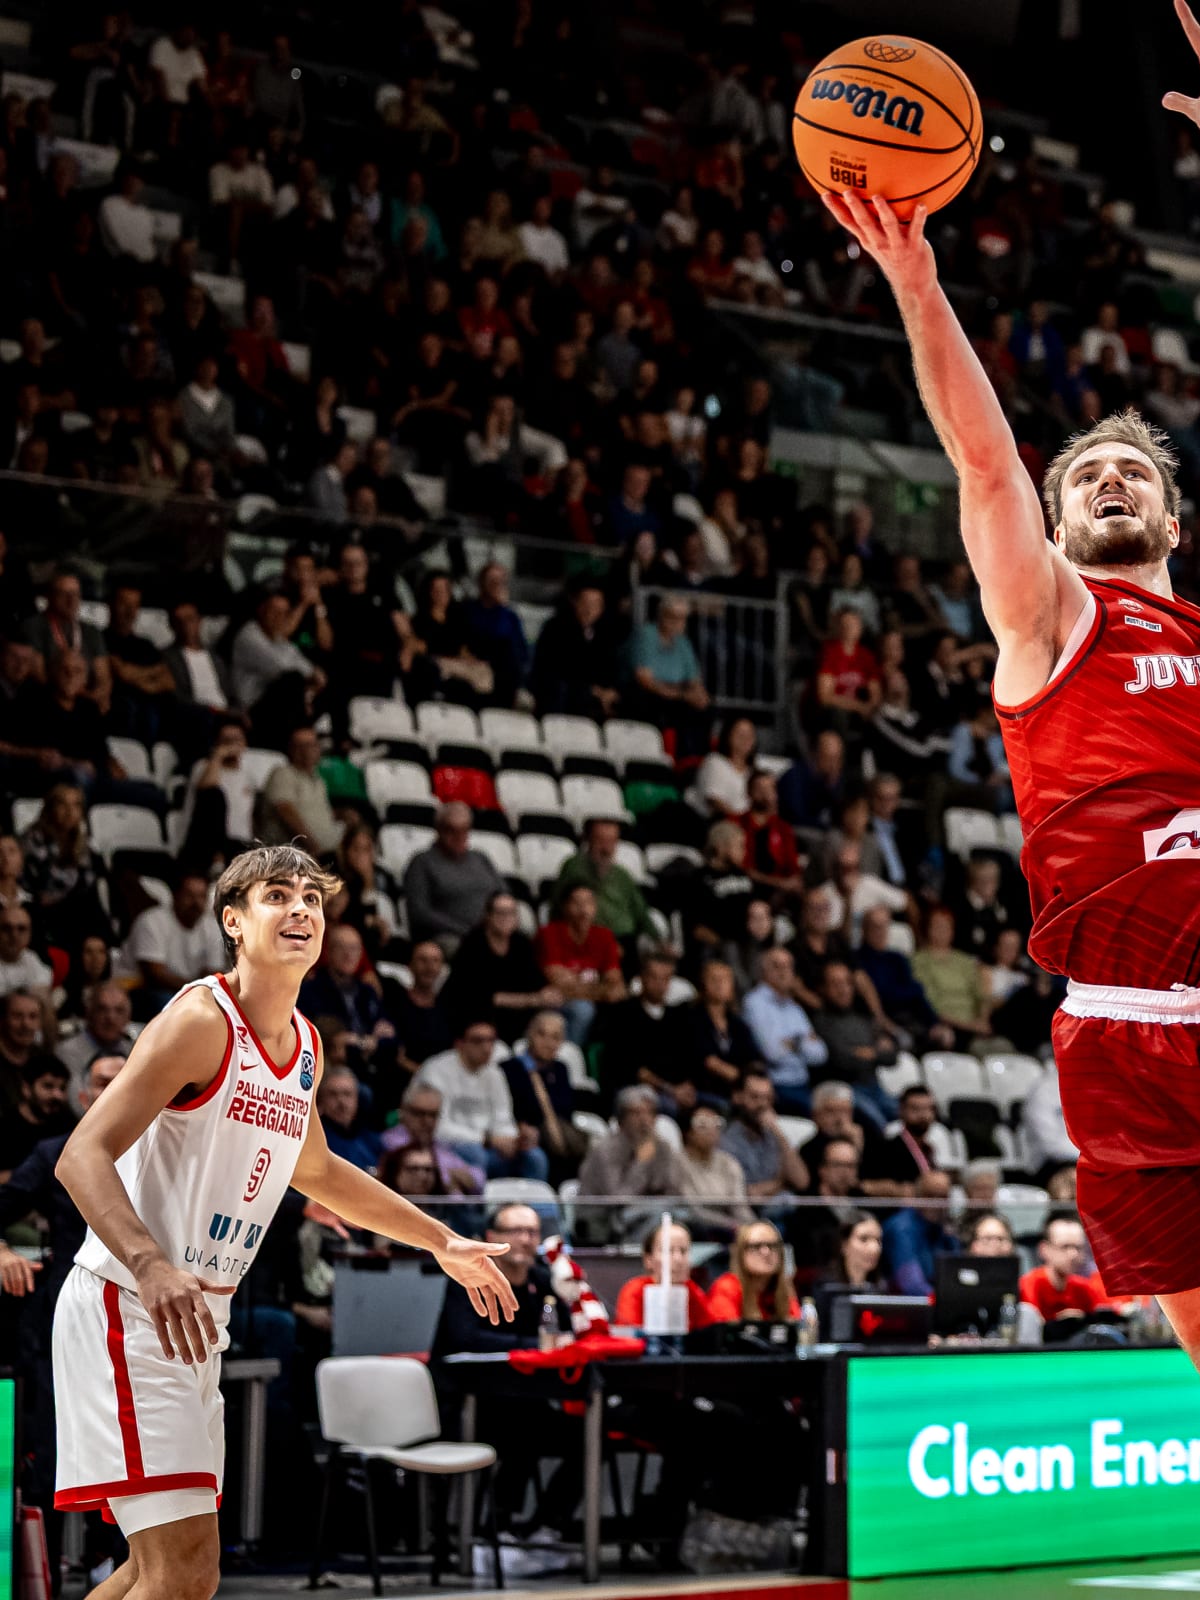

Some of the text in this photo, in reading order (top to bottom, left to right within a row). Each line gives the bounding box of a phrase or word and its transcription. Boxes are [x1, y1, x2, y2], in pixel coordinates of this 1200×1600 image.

[811, 79, 924, 136] Wilson
[830, 165, 867, 189] FIBA
[226, 1096, 304, 1141] REGGIANA
[234, 1080, 309, 1118] PALLACANESTRO
[243, 1147, 272, 1203] 9
[908, 1421, 1075, 1498] Clean
